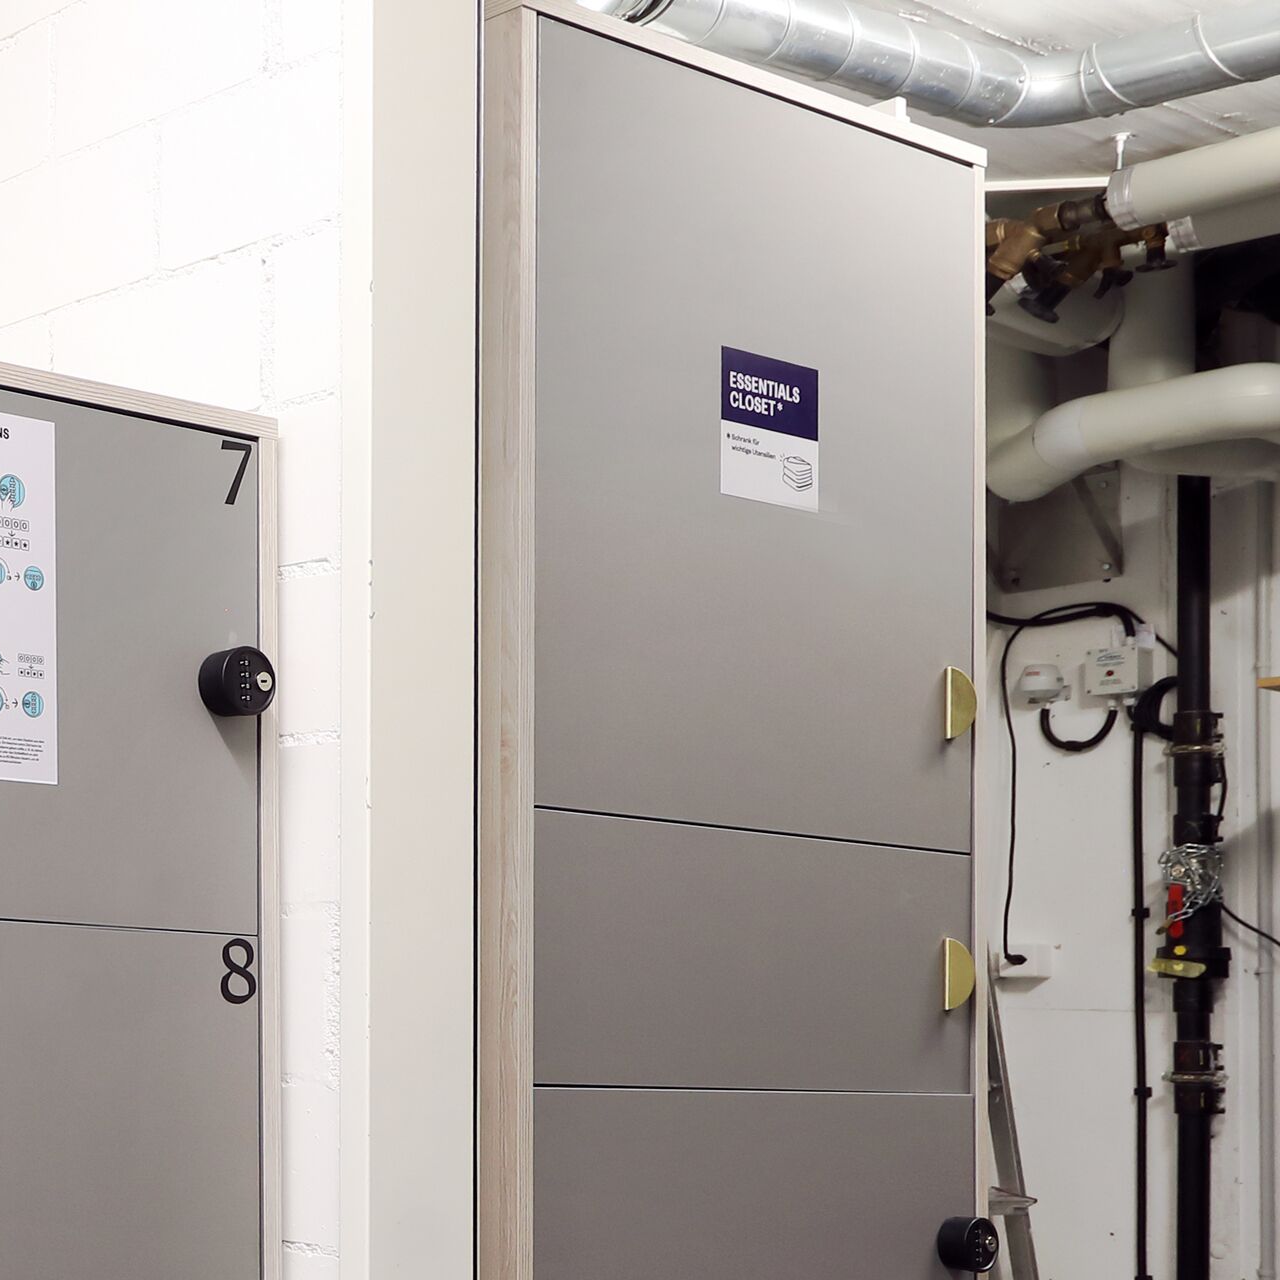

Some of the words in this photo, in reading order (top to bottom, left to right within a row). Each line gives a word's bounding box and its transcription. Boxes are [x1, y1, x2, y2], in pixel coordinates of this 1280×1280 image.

[729, 371, 800, 404] ESSENTIALS
[221, 439, 252, 505] 7
[221, 938, 256, 1004] 8
